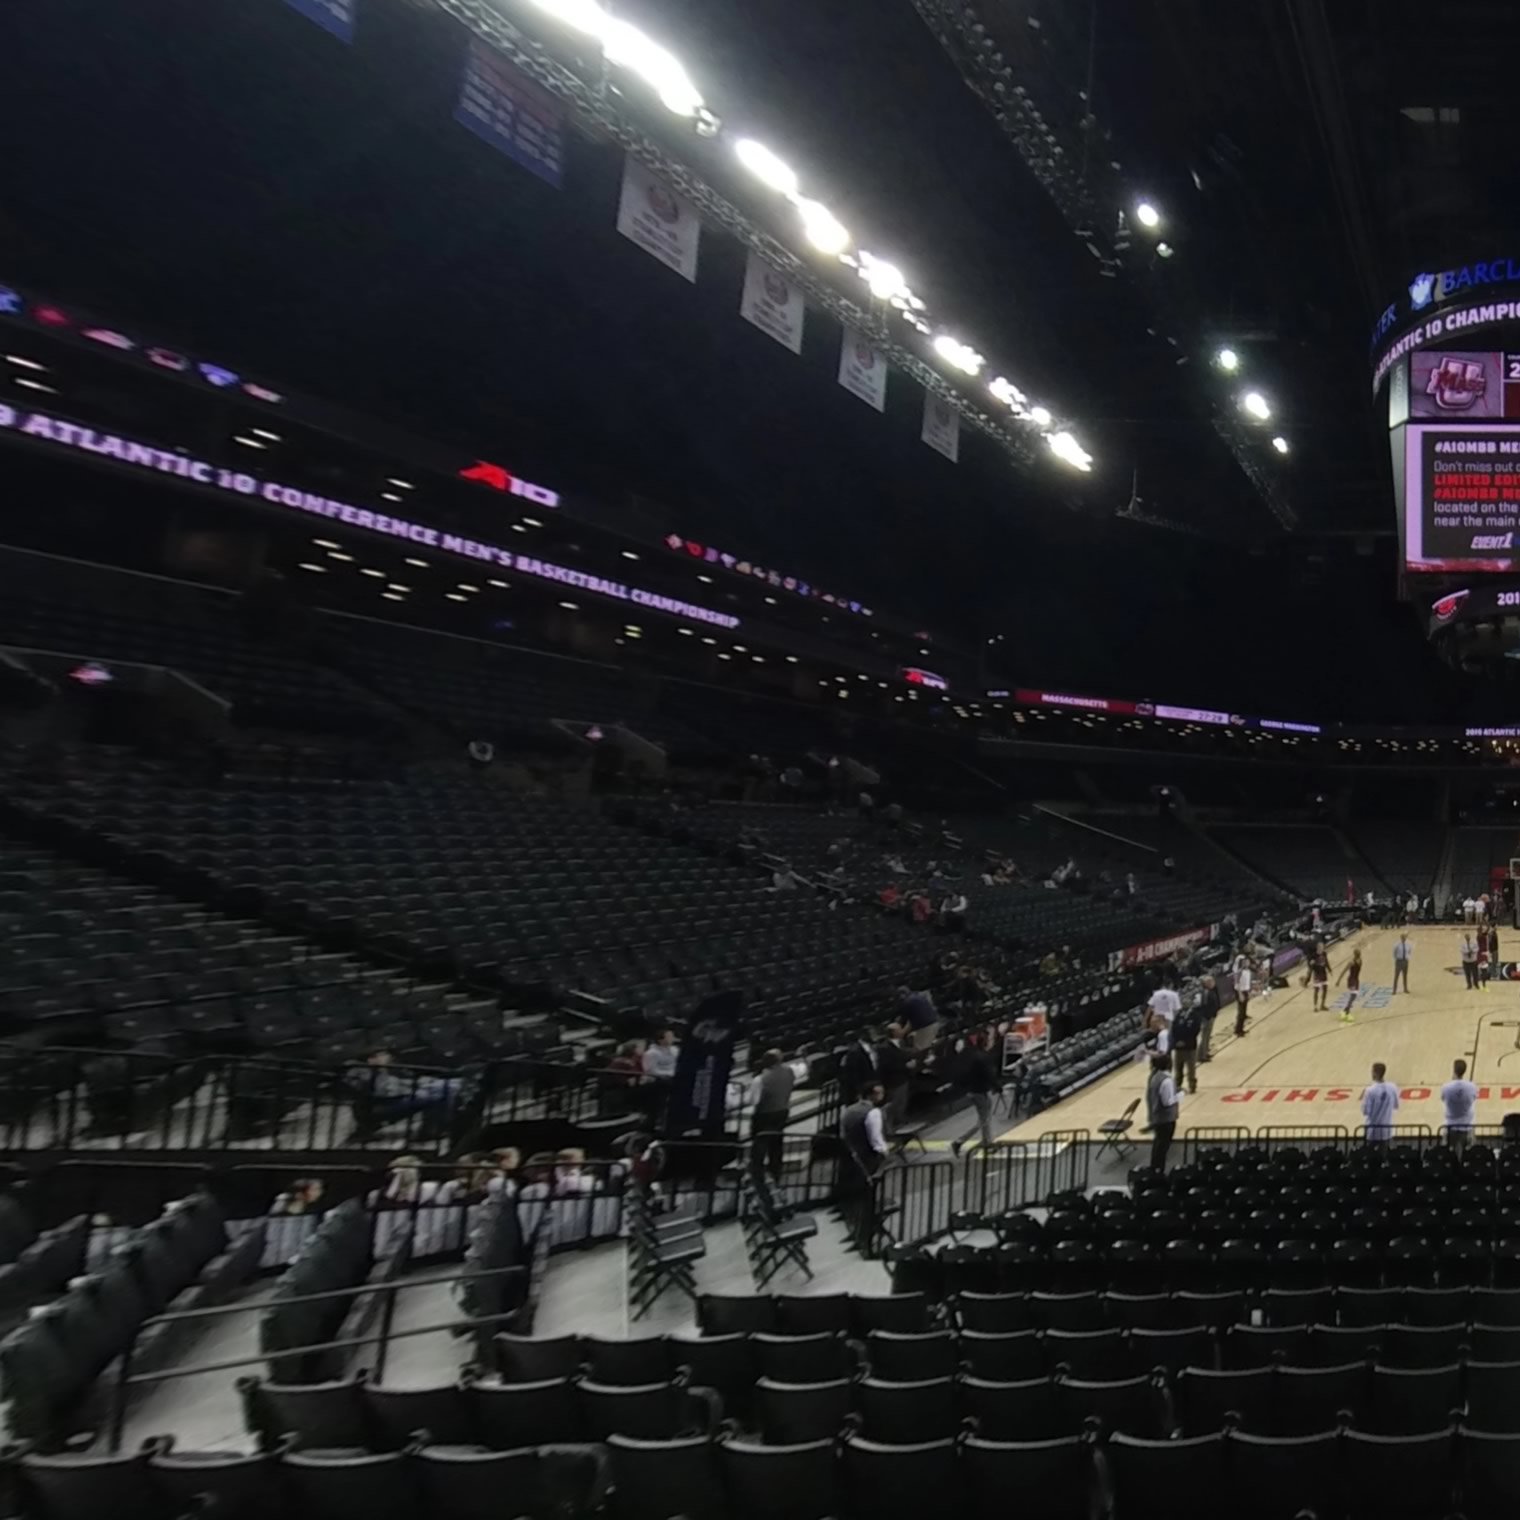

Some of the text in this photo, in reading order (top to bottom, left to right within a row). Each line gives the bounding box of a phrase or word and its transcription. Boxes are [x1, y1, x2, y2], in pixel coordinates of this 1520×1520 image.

[1426, 319, 1442, 339] 10
[1434, 441, 1497, 454] #A10MBB
[1434, 460, 1464, 473] Don't
[1465, 461, 1492, 473] miss
[1494, 462, 1514, 473] out
[457, 459, 561, 509] A10
[1434, 474, 1491, 487] LIMITED
[1434, 487, 1499, 501] #A10MBB
[1433, 502, 1478, 514] located
[1480, 503, 1496, 514] on
[1498, 502, 1518, 514] the
[19, 413, 215, 483] ATLANTIC
[217, 468, 257, 495] 10
[261, 482, 437, 546] CONFERENCE
[440, 532, 512, 567] MEN'S
[515, 555, 628, 600] BASKETBALL
[630, 588, 742, 630] CHAMPIONSHIP
[1434, 517, 1460, 528] near
[1462, 516, 1482, 528] the
[1485, 516, 1515, 528] main
